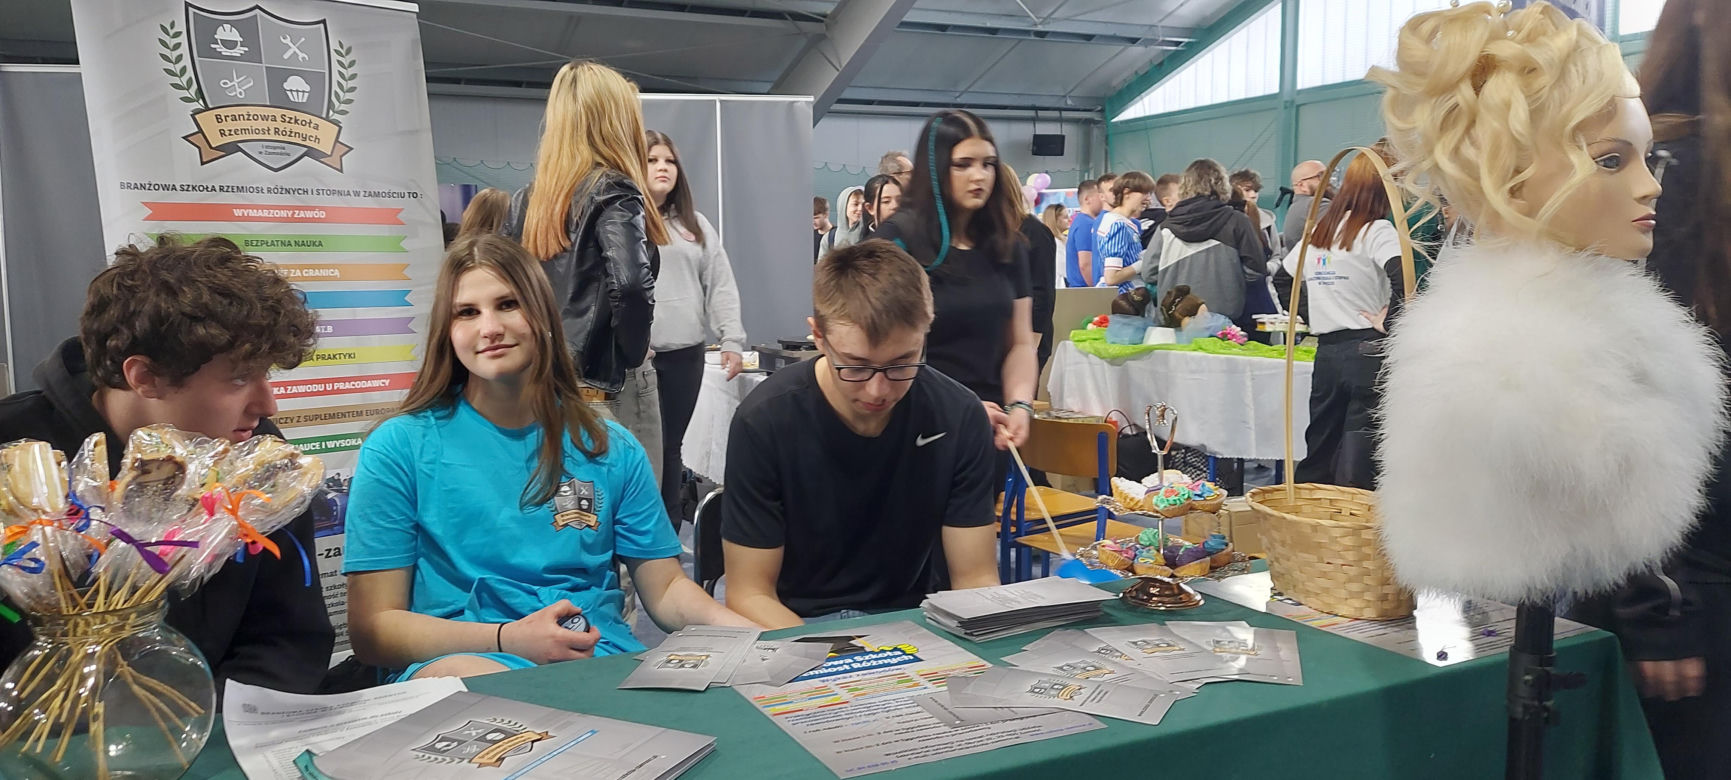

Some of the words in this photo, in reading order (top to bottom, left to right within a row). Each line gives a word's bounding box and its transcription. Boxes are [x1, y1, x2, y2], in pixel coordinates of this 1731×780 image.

[214, 111, 278, 124] Branżowa
[280, 113, 320, 131] Szkoła
[218, 126, 271, 138] Rzemiosł
[273, 127, 321, 145] Różnych
[119, 181, 178, 192] BRANŻOWA
[179, 184, 217, 193] SZKOŁA
[218, 184, 265, 194] RZEMIOSŁ
[266, 185, 309, 196] RÓŻNYCH
[310, 188, 314, 196] I
[315, 188, 351, 197] STOPNIA
[352, 190, 361, 198] W
[362, 189, 406, 199] ZAMOŚCIU
[407, 191, 418, 199] TO
[232, 208, 293, 218] WYMARZONY
[294, 208, 327, 218] ZAWÓD
[243, 239, 293, 248] BEZPŁATNA
[294, 239, 324, 248] NAUKA
[290, 268, 302, 277] ZA
[302, 268, 340, 279] GRANICĄ
[315, 352, 356, 361] PRAKTYKI
[286, 383, 324, 394] ZAWODU
[333, 379, 391, 390] PRACODAWCY
[303, 410, 364, 423] SUPLEMENTEM
[326, 438, 363, 449] WYSOKA
[317, 546, 343, 559] -za
[800, 662, 852, 677] emiosł
[852, 654, 915, 669] Różnych
[822, 656, 854, 667] owa
